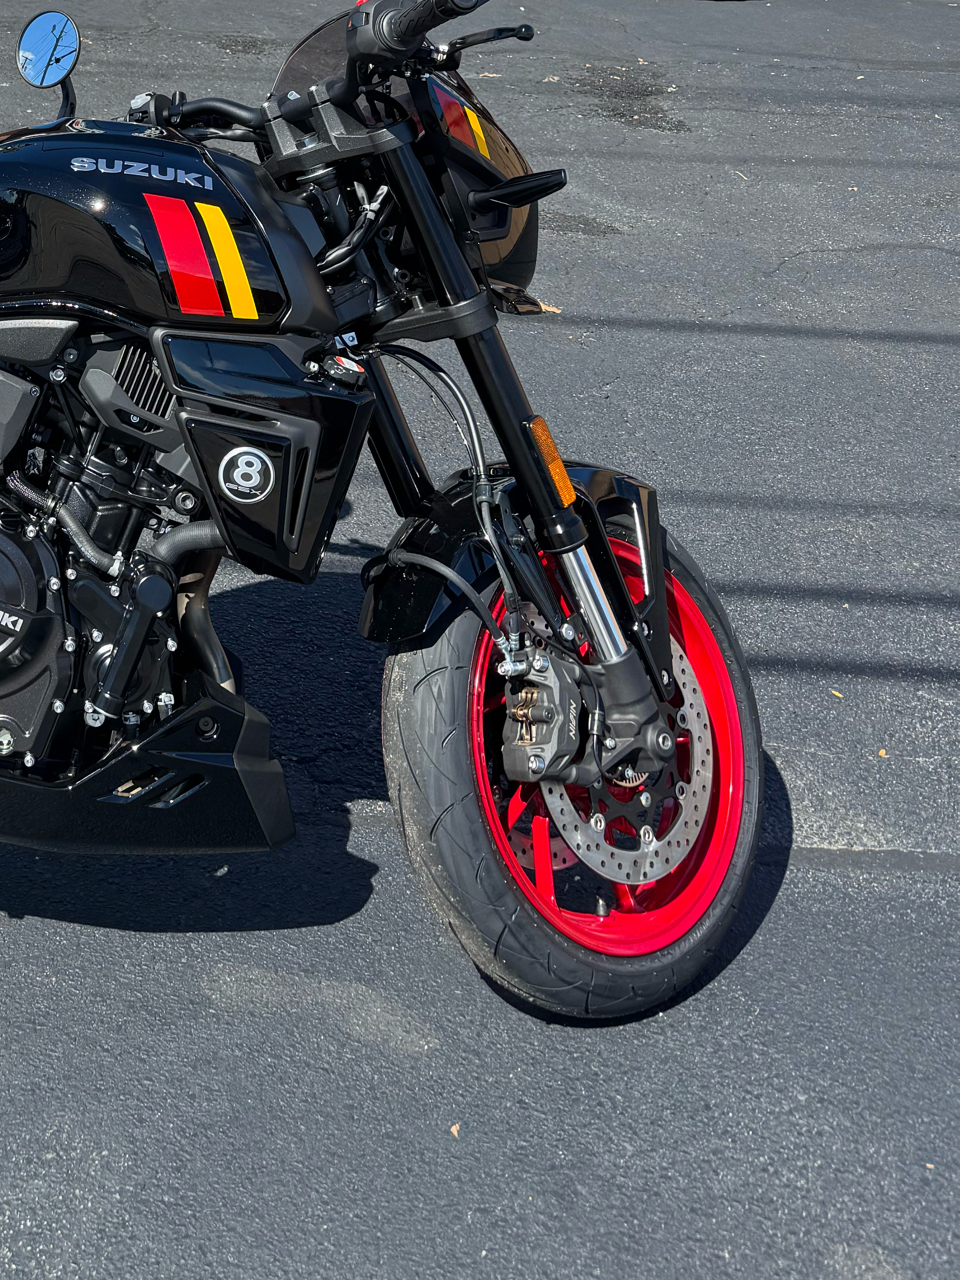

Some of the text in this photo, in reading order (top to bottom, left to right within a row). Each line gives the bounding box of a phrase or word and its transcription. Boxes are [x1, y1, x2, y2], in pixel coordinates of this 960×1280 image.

[70, 157, 214, 191] SUZUKI
[233, 455, 262, 488] 8
[225, 482, 262, 496] GSX
